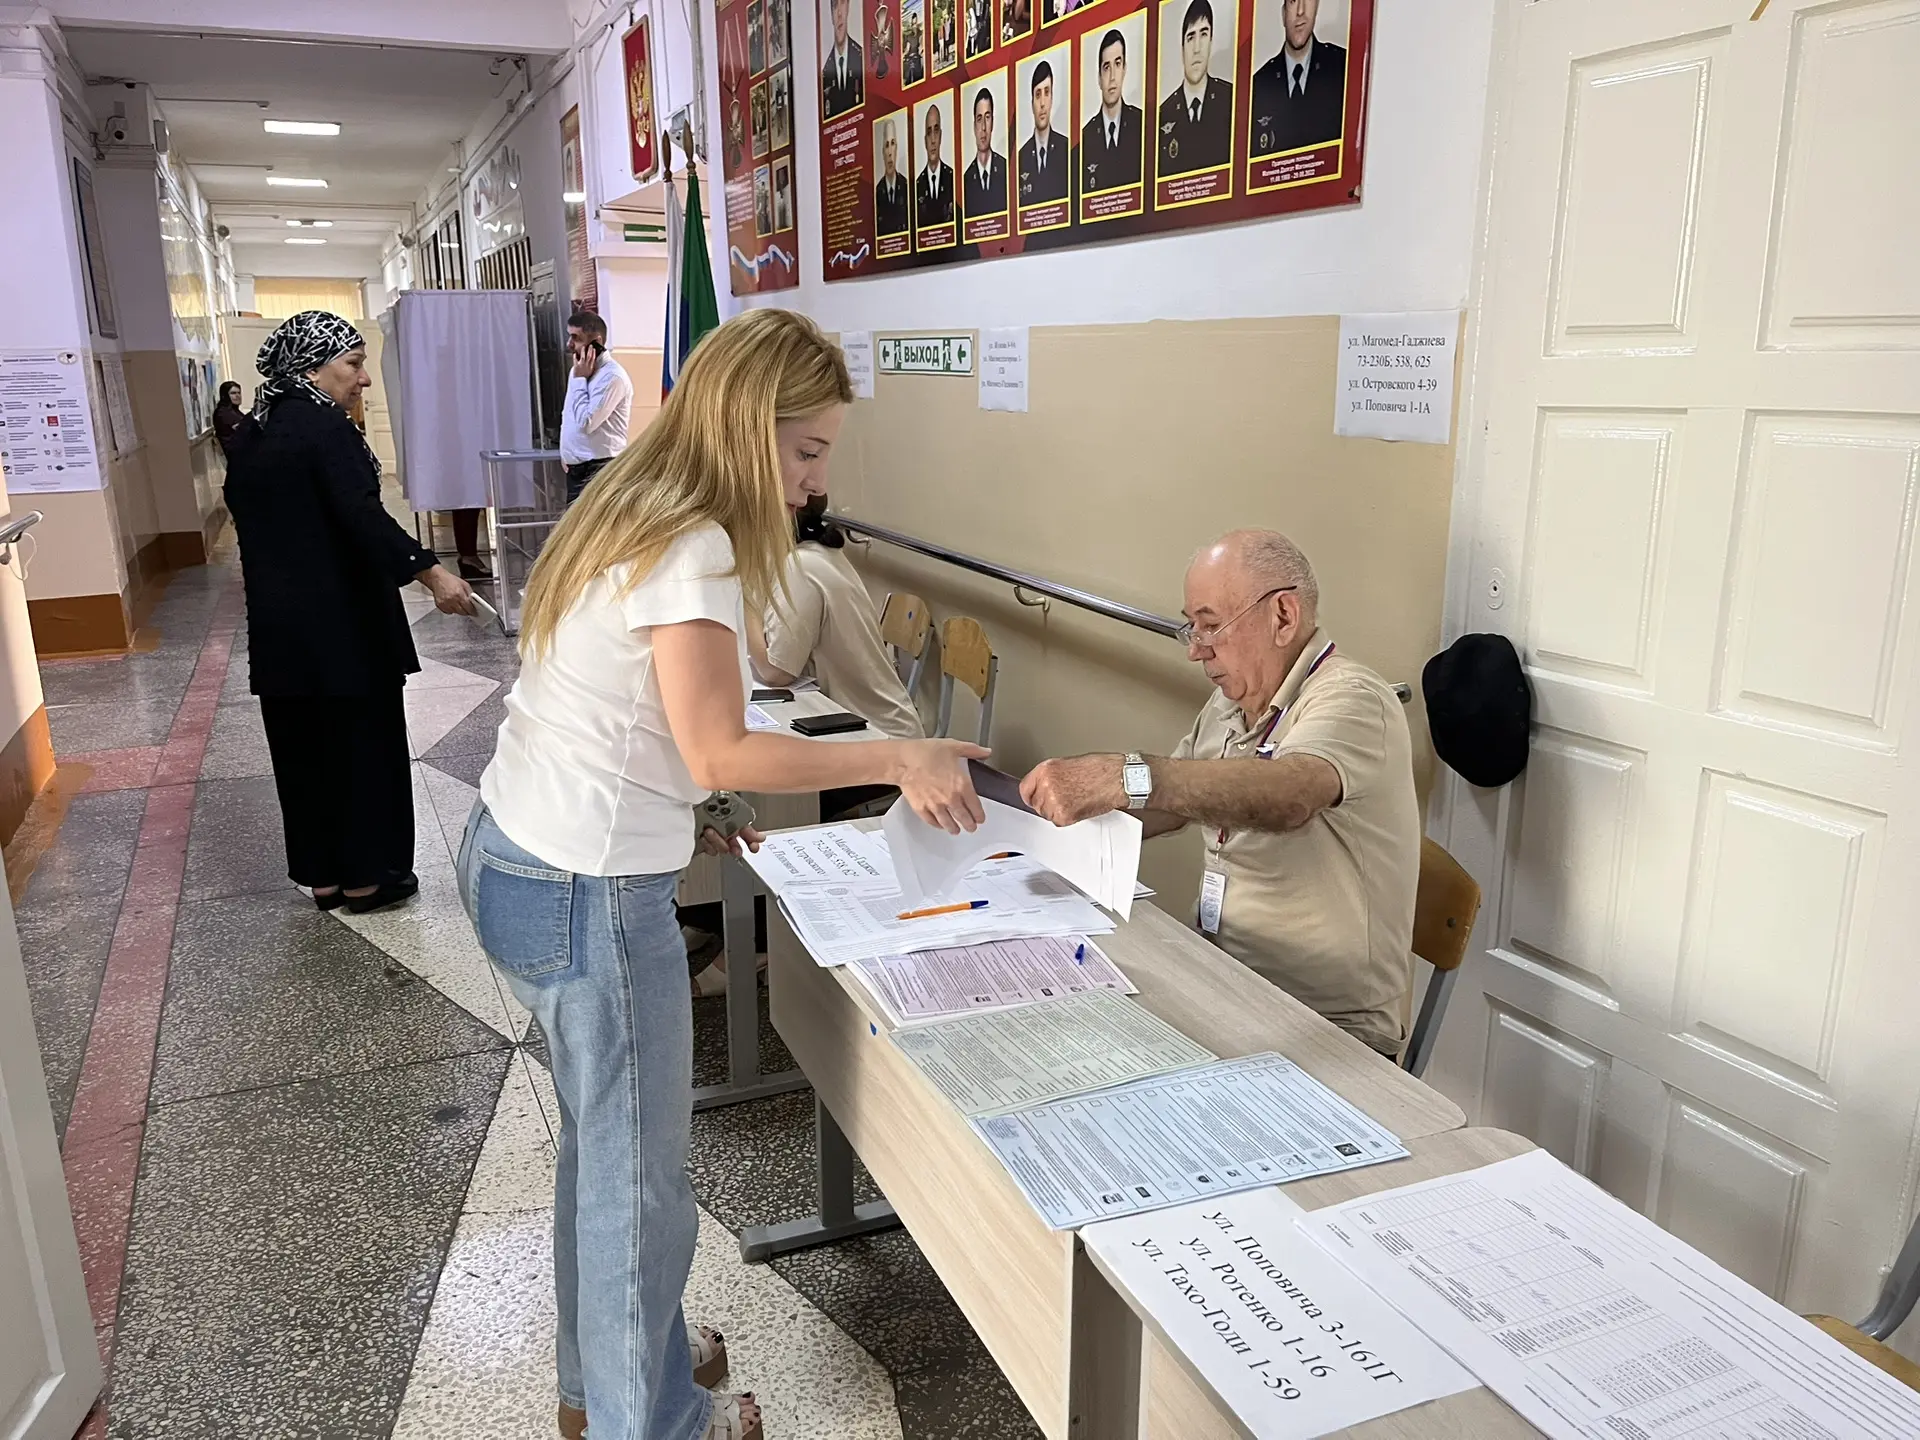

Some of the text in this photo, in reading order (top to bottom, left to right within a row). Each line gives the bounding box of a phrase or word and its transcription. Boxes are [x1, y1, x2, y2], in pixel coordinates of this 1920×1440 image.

[1348, 334, 1446, 349] ул. Магомед-Гаджиева
[904, 345, 940, 366] ВЫХОД
[1414, 355, 1431, 368] 625
[1348, 377, 1437, 392] ул. Островского 4-39
[1351, 399, 1431, 414] ул. Поповича 1-1А
[1202, 1210, 1235, 1236] ул.
[1233, 1235, 1324, 1320] Поповича
[1319, 1319, 1404, 1384] 3-161Г
[1179, 1236, 1338, 1379] ул. Ротенко 1-16
[1132, 1237, 1302, 1401] ул. Тахо-Годи 1-59
